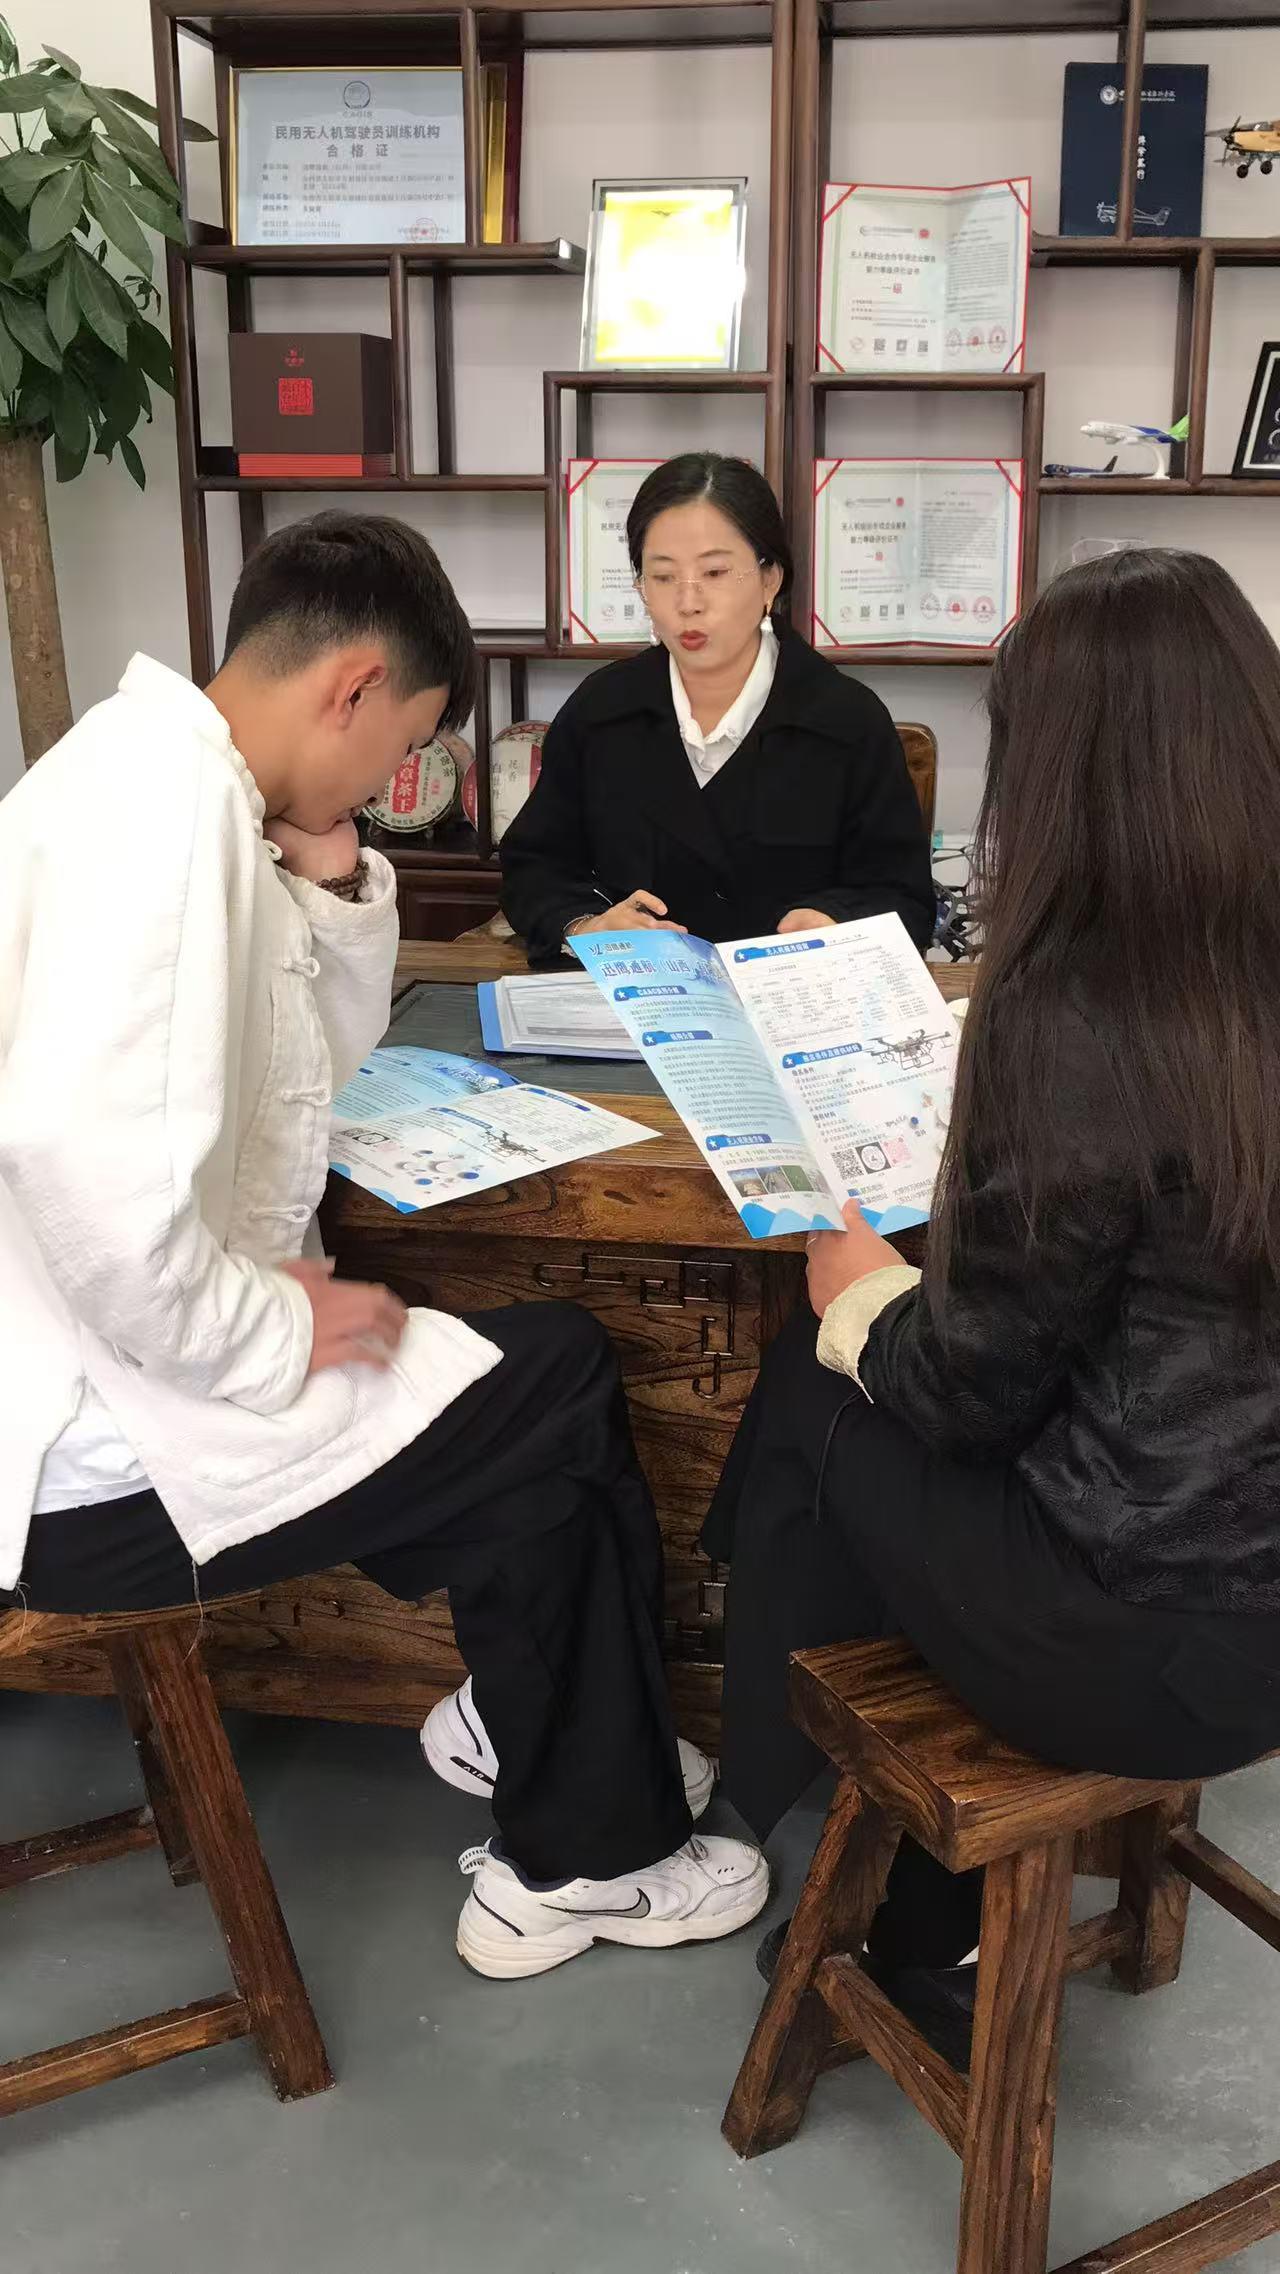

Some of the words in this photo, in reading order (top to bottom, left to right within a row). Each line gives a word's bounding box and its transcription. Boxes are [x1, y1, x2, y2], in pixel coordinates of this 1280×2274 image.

[275, 125, 441, 140] 民用无人机驾驶员训练机构
[327, 144, 389, 158] 合格证
[464, 1766, 485, 1778] AIR
